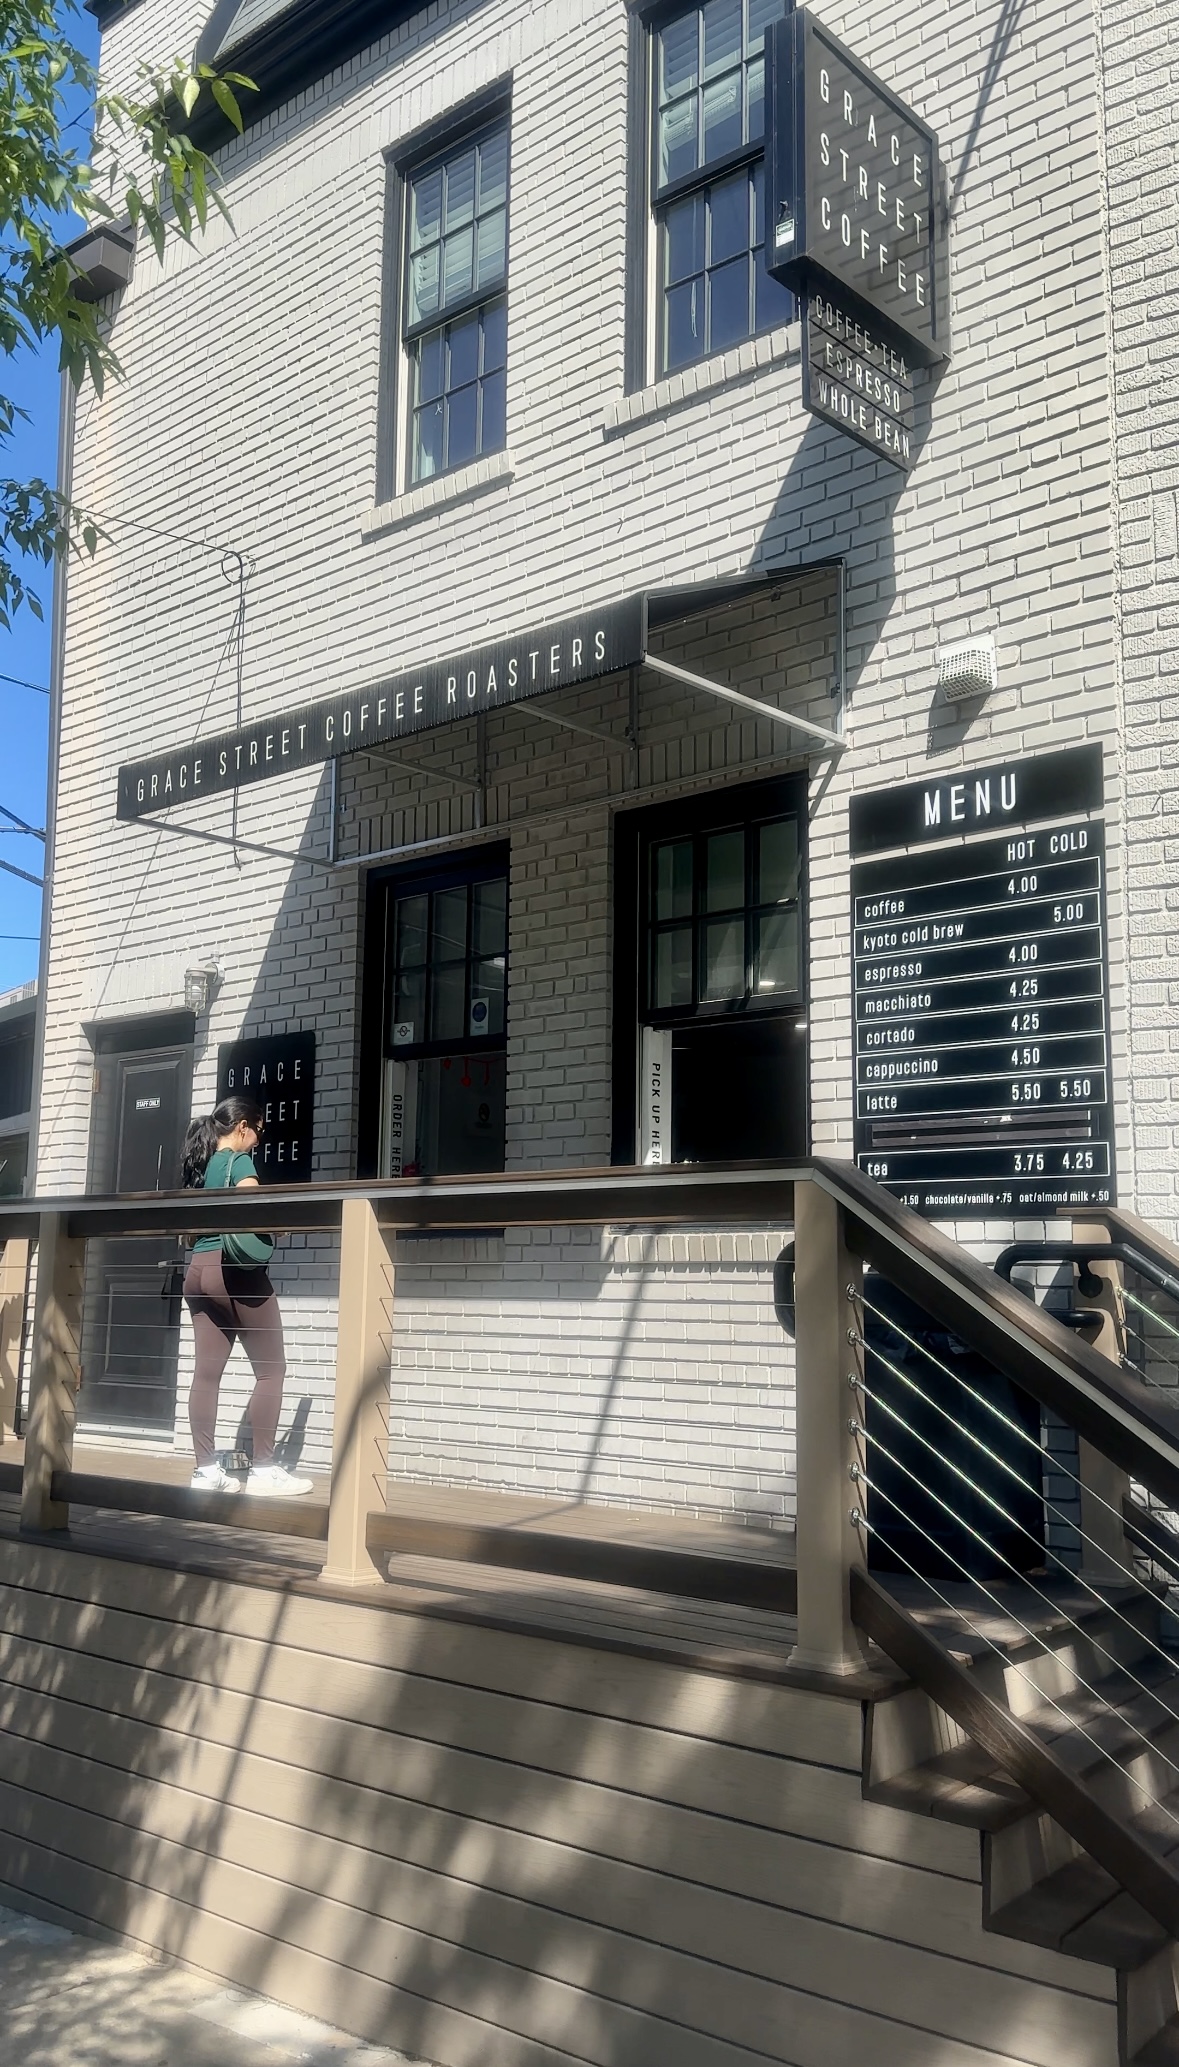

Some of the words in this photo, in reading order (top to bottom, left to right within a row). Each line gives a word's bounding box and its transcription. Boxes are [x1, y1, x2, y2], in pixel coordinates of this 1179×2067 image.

[820, 68, 923, 188] GRACE
[820, 132, 923, 245] STREET
[820, 196, 925, 308] COFFEE
[825, 341, 901, 413] ESPRESSO
[818, 378, 867, 431] WHOLE
[874, 415, 911, 459] BEAN
[136, 759, 202, 802] GRACE
[219, 724, 308, 777] STREET
[325, 685, 424, 742] COFFEE
[446, 630, 606, 705] ROASTERS
[923, 773, 1017, 827] MENU
[1007, 839, 1036, 862] HOT
[1049, 830, 1088, 854] COLD
[864, 900, 905, 918] coffee
[1007, 875, 1038, 895] 4.00
[863, 933, 897, 952] kyoto
[901, 925, 929, 944] cold
[933, 923, 965, 939] brew
[1053, 903, 1084, 923] 5.00
[864, 962, 923, 983] espresso
[1008, 944, 1038, 964] 4.00
[865, 993, 932, 1014] macchiato
[1009, 979, 1039, 998] 4.25
[866, 1026, 916, 1046] cortado
[1011, 1013, 1040, 1032] 4.25
[228, 1060, 301, 1088] GRACE
[652, 1063, 661, 1098] PICK
[866, 1057, 939, 1083] cappuccino
[1011, 1047, 1041, 1066] 4.50
[265, 1100, 300, 1123] EET
[866, 1095, 898, 1110] latte
[1060, 1079, 1092, 1098] 5.50
[392, 1094, 403, 1138] ORDER
[652, 1105, 660, 1124] UP
[251, 1141, 299, 1163] FFEE
[867, 1161, 889, 1177] tea
[1014, 1153, 1045, 1172] 3.75
[1062, 1151, 1094, 1170] 4.25
[925, 1193, 994, 1205] chocolate/vanilla
[1019, 1191, 1068, 1203] oat/almond
[1070, 1191, 1089, 1202] milk
